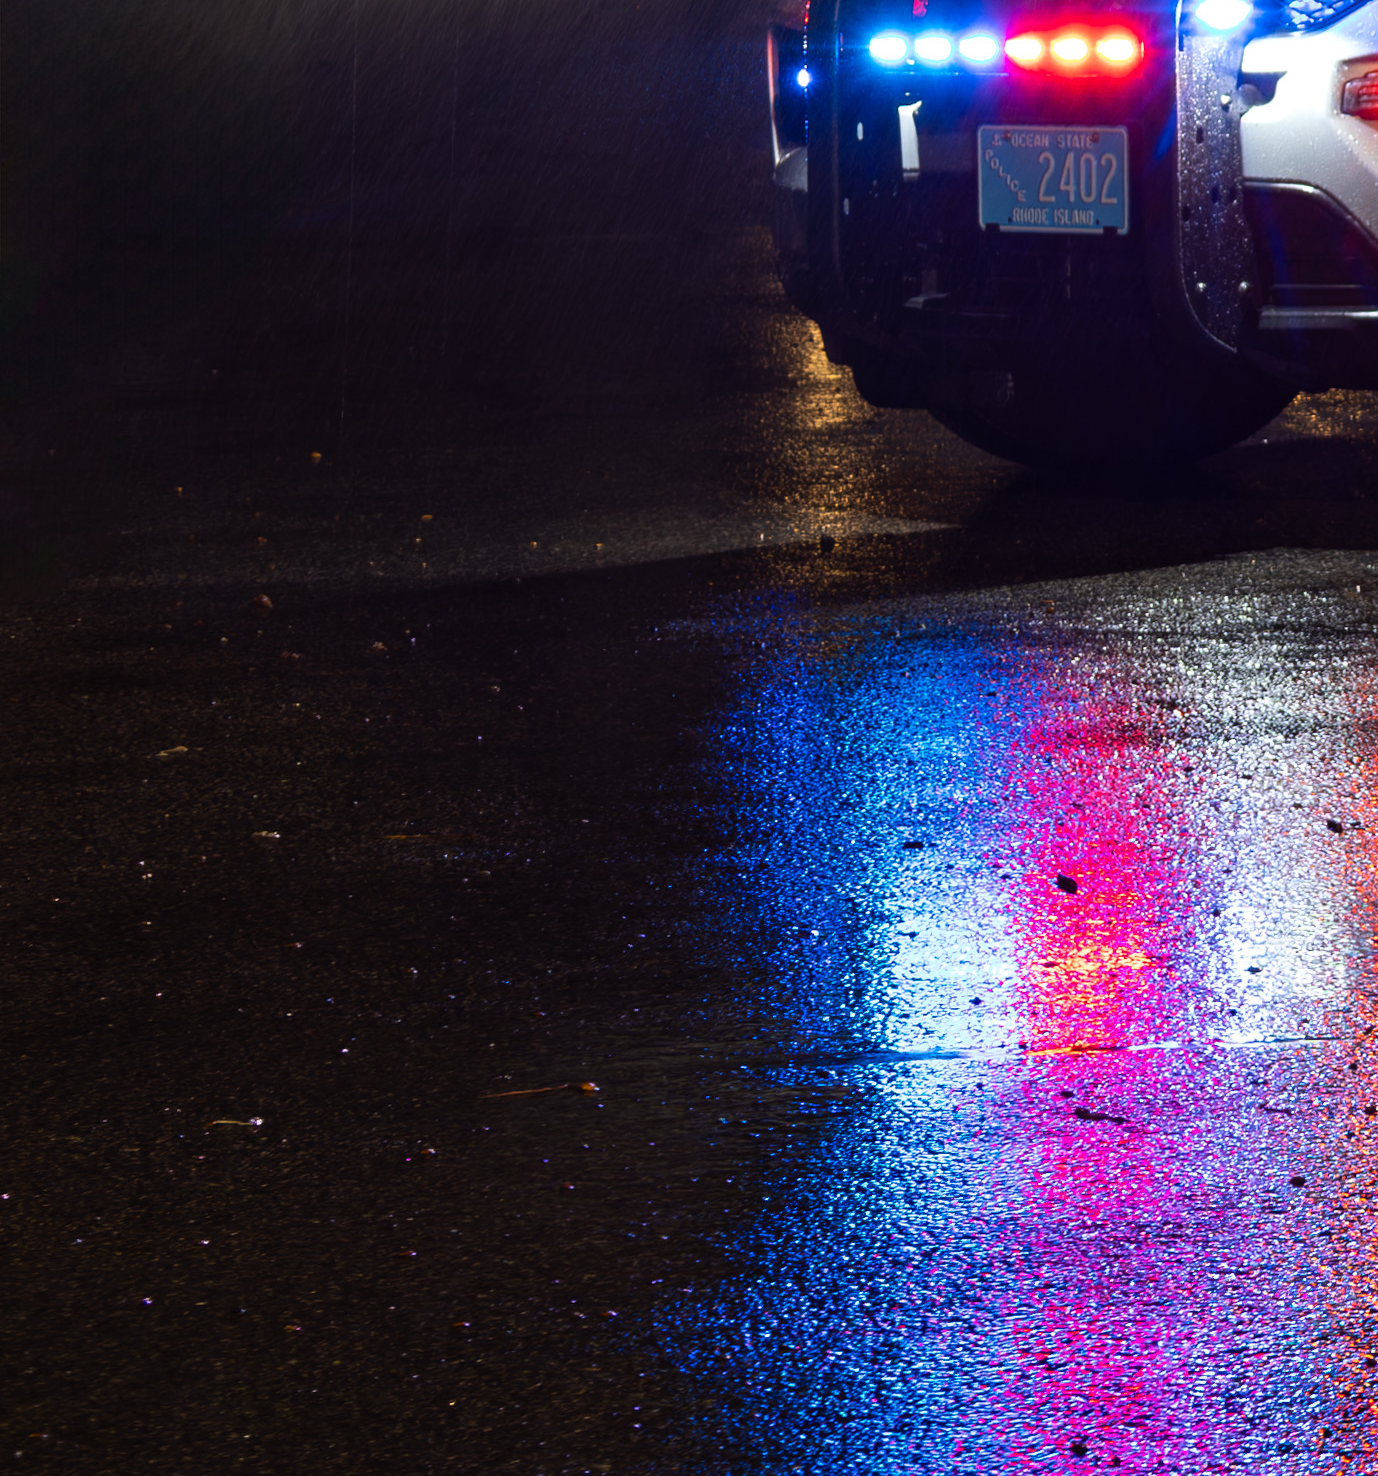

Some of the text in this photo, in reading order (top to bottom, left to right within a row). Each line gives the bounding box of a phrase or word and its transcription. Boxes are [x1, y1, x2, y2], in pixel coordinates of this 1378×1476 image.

[1011, 131, 1094, 149] OCEAN STATE
[984, 149, 1027, 203] POLICE
[1038, 151, 1118, 204] 2402
[1012, 207, 1094, 226] RHODE ISLAND
